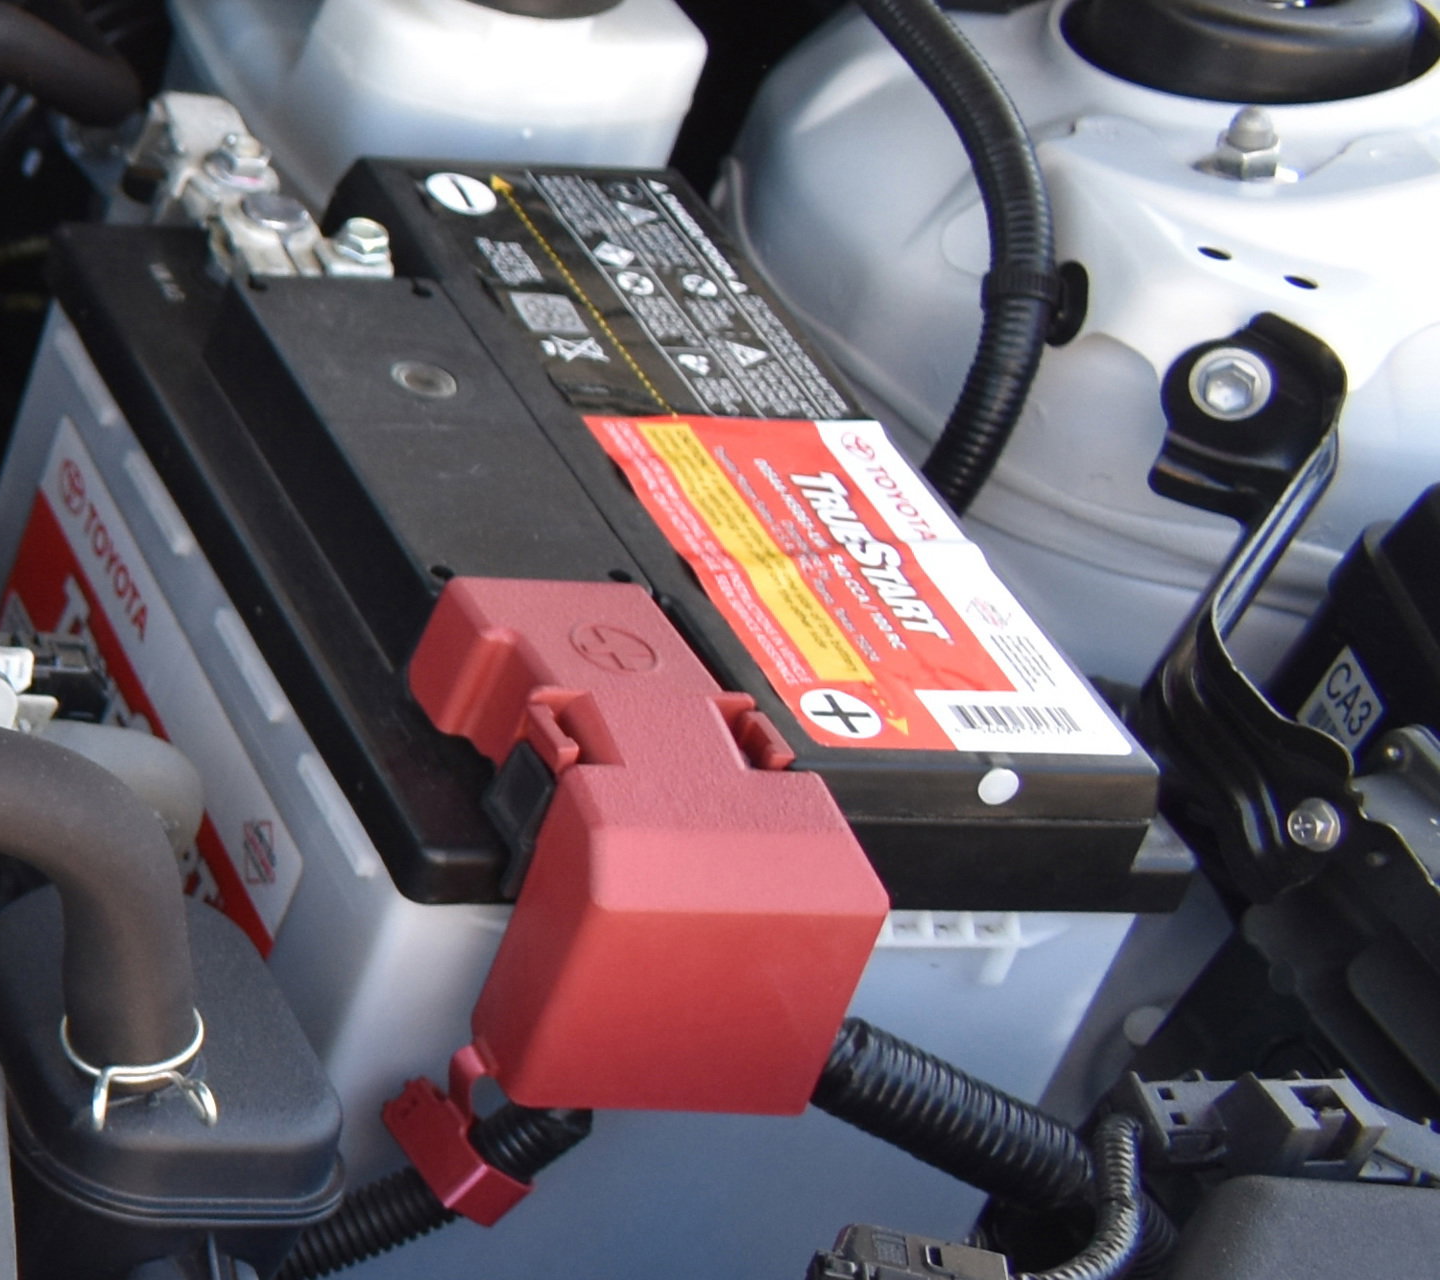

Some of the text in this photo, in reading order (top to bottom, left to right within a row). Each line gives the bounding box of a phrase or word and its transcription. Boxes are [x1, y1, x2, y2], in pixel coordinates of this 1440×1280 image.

[867, 466, 938, 540] TOYOTA
[83, 501, 148, 643] TOYOTA
[1327, 662, 1372, 735] CA3
